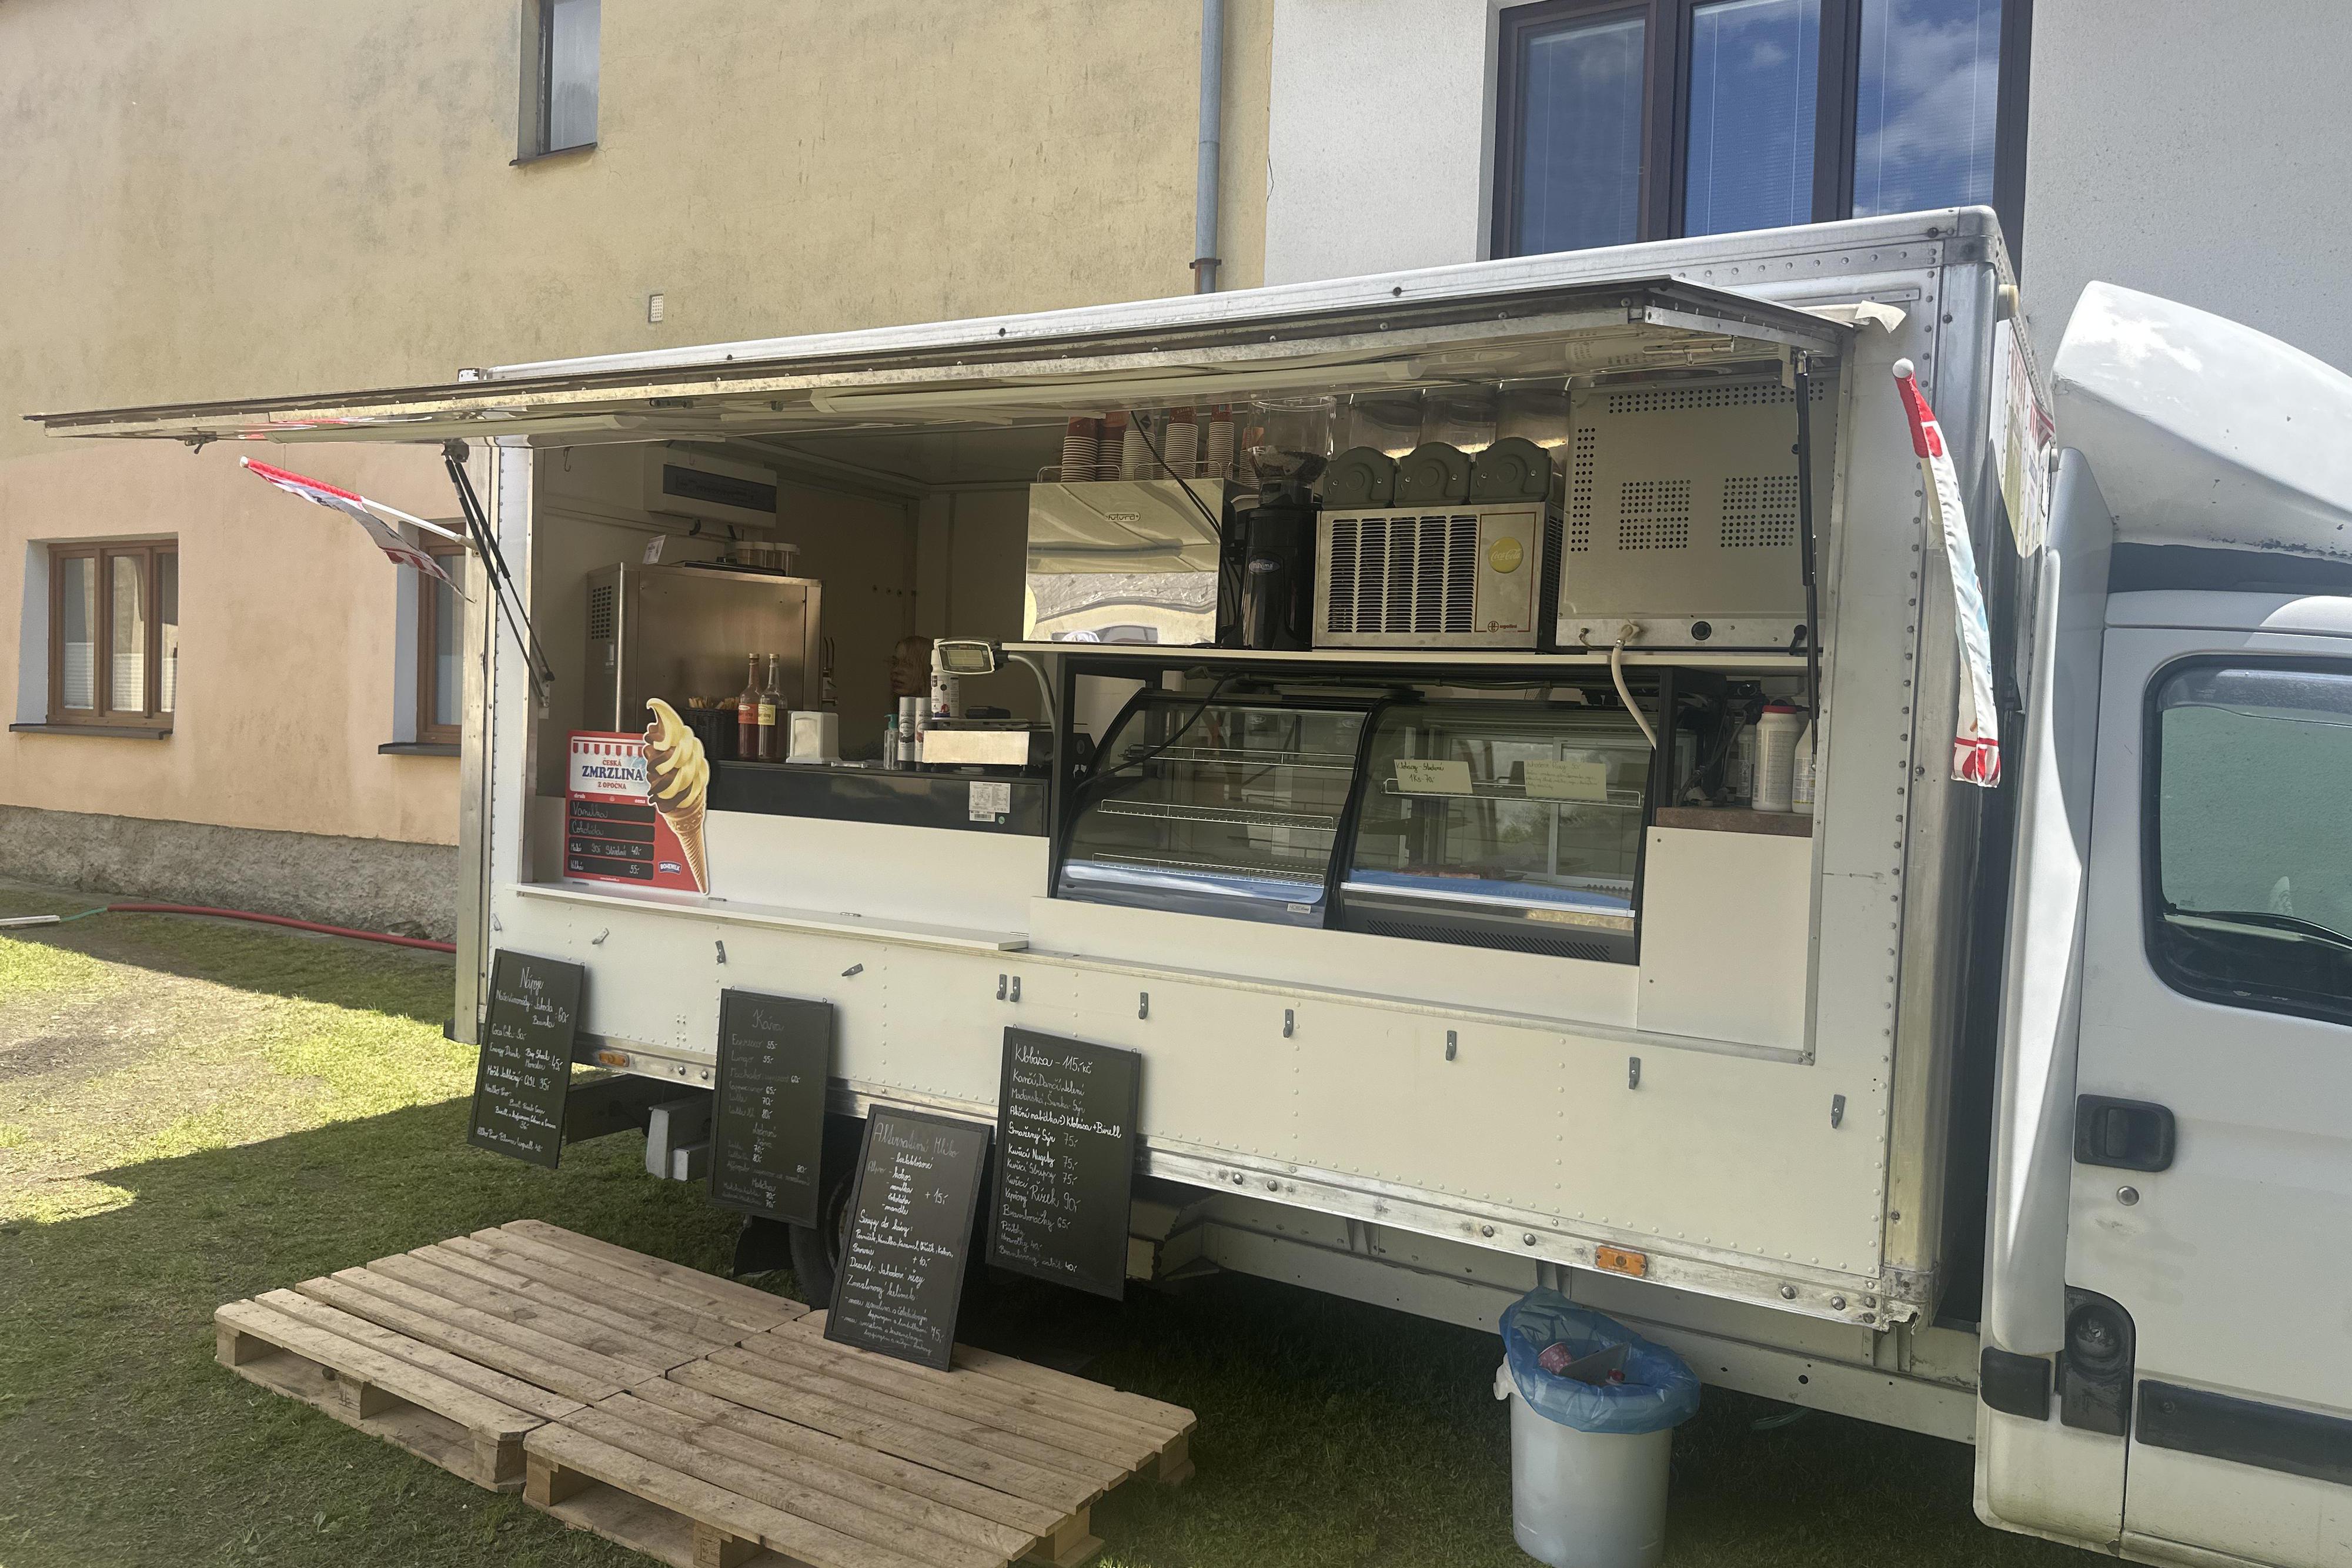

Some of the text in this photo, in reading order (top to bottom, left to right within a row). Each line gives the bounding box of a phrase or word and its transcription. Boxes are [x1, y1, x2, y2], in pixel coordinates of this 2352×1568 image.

[602, 757, 622, 767] ČESKÁ
[582, 765, 644, 781] ZMRZLINA
[751, 1008, 784, 1031] Káva
[1015, 1042, 1054, 1066] Klobása
